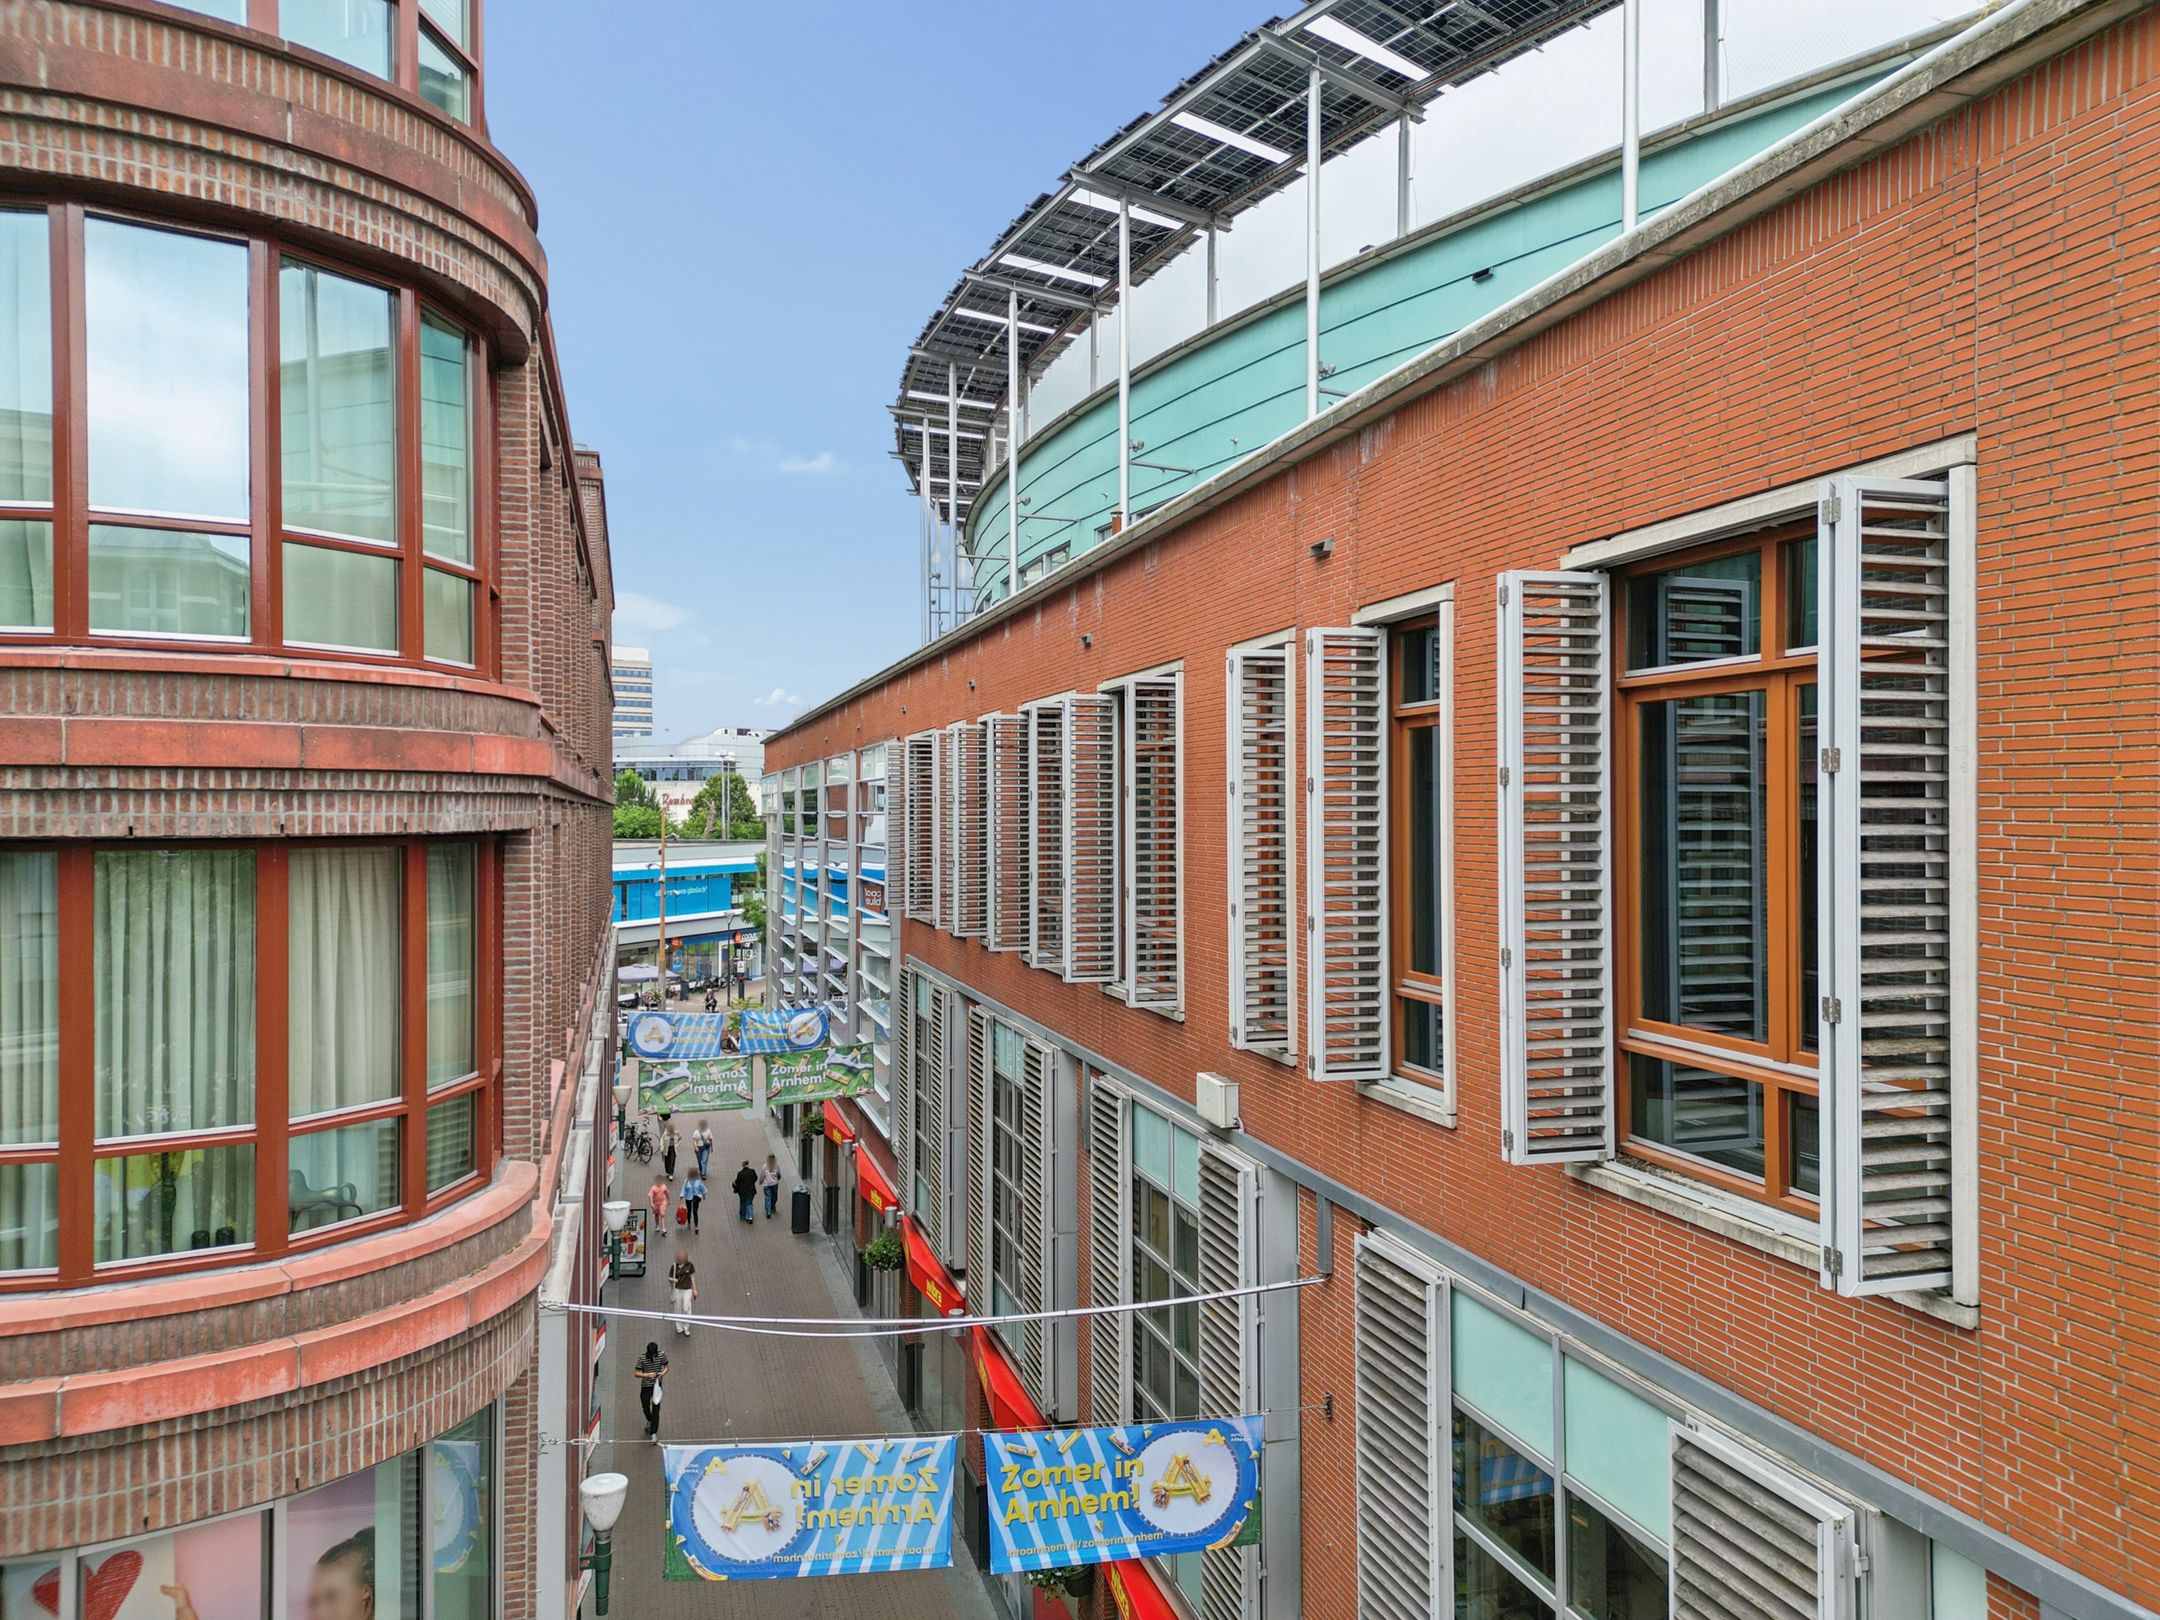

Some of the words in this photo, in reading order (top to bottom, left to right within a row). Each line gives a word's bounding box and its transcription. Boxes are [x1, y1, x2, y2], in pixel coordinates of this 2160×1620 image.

[770, 1063, 812, 1075] Zomer
[816, 1061, 828, 1071] in
[771, 1072, 826, 1088] Arnhem!
[1001, 1461, 1105, 1493] Zomer
[1115, 1455, 1144, 1477] in
[1003, 1483, 1140, 1526] Arnhem!
